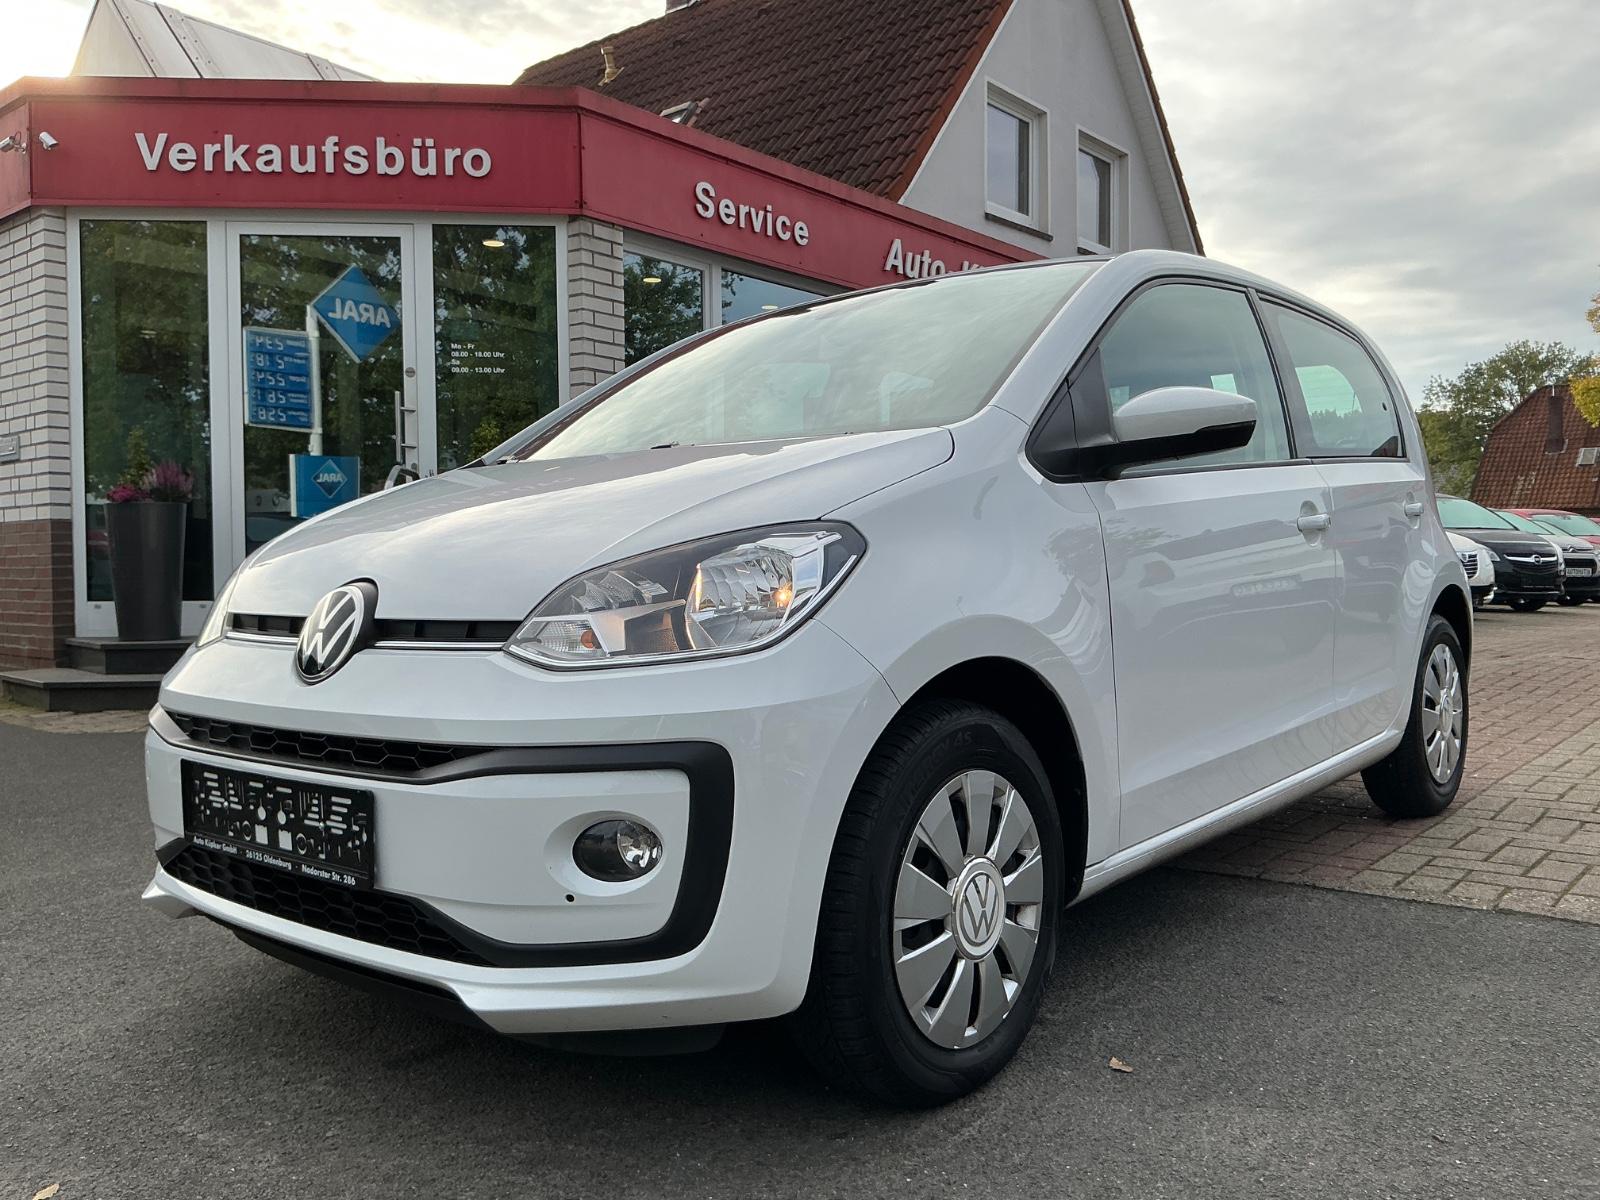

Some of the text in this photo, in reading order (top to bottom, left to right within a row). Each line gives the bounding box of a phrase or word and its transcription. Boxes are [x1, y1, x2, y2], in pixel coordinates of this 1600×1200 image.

[134, 132, 493, 178] Verkaufsbüro
[694, 181, 809, 246] Service
[193, 835, 205, 846] Auto
[263, 854, 292, 870] Oldenburg
[332, 871, 342, 882] Str.
